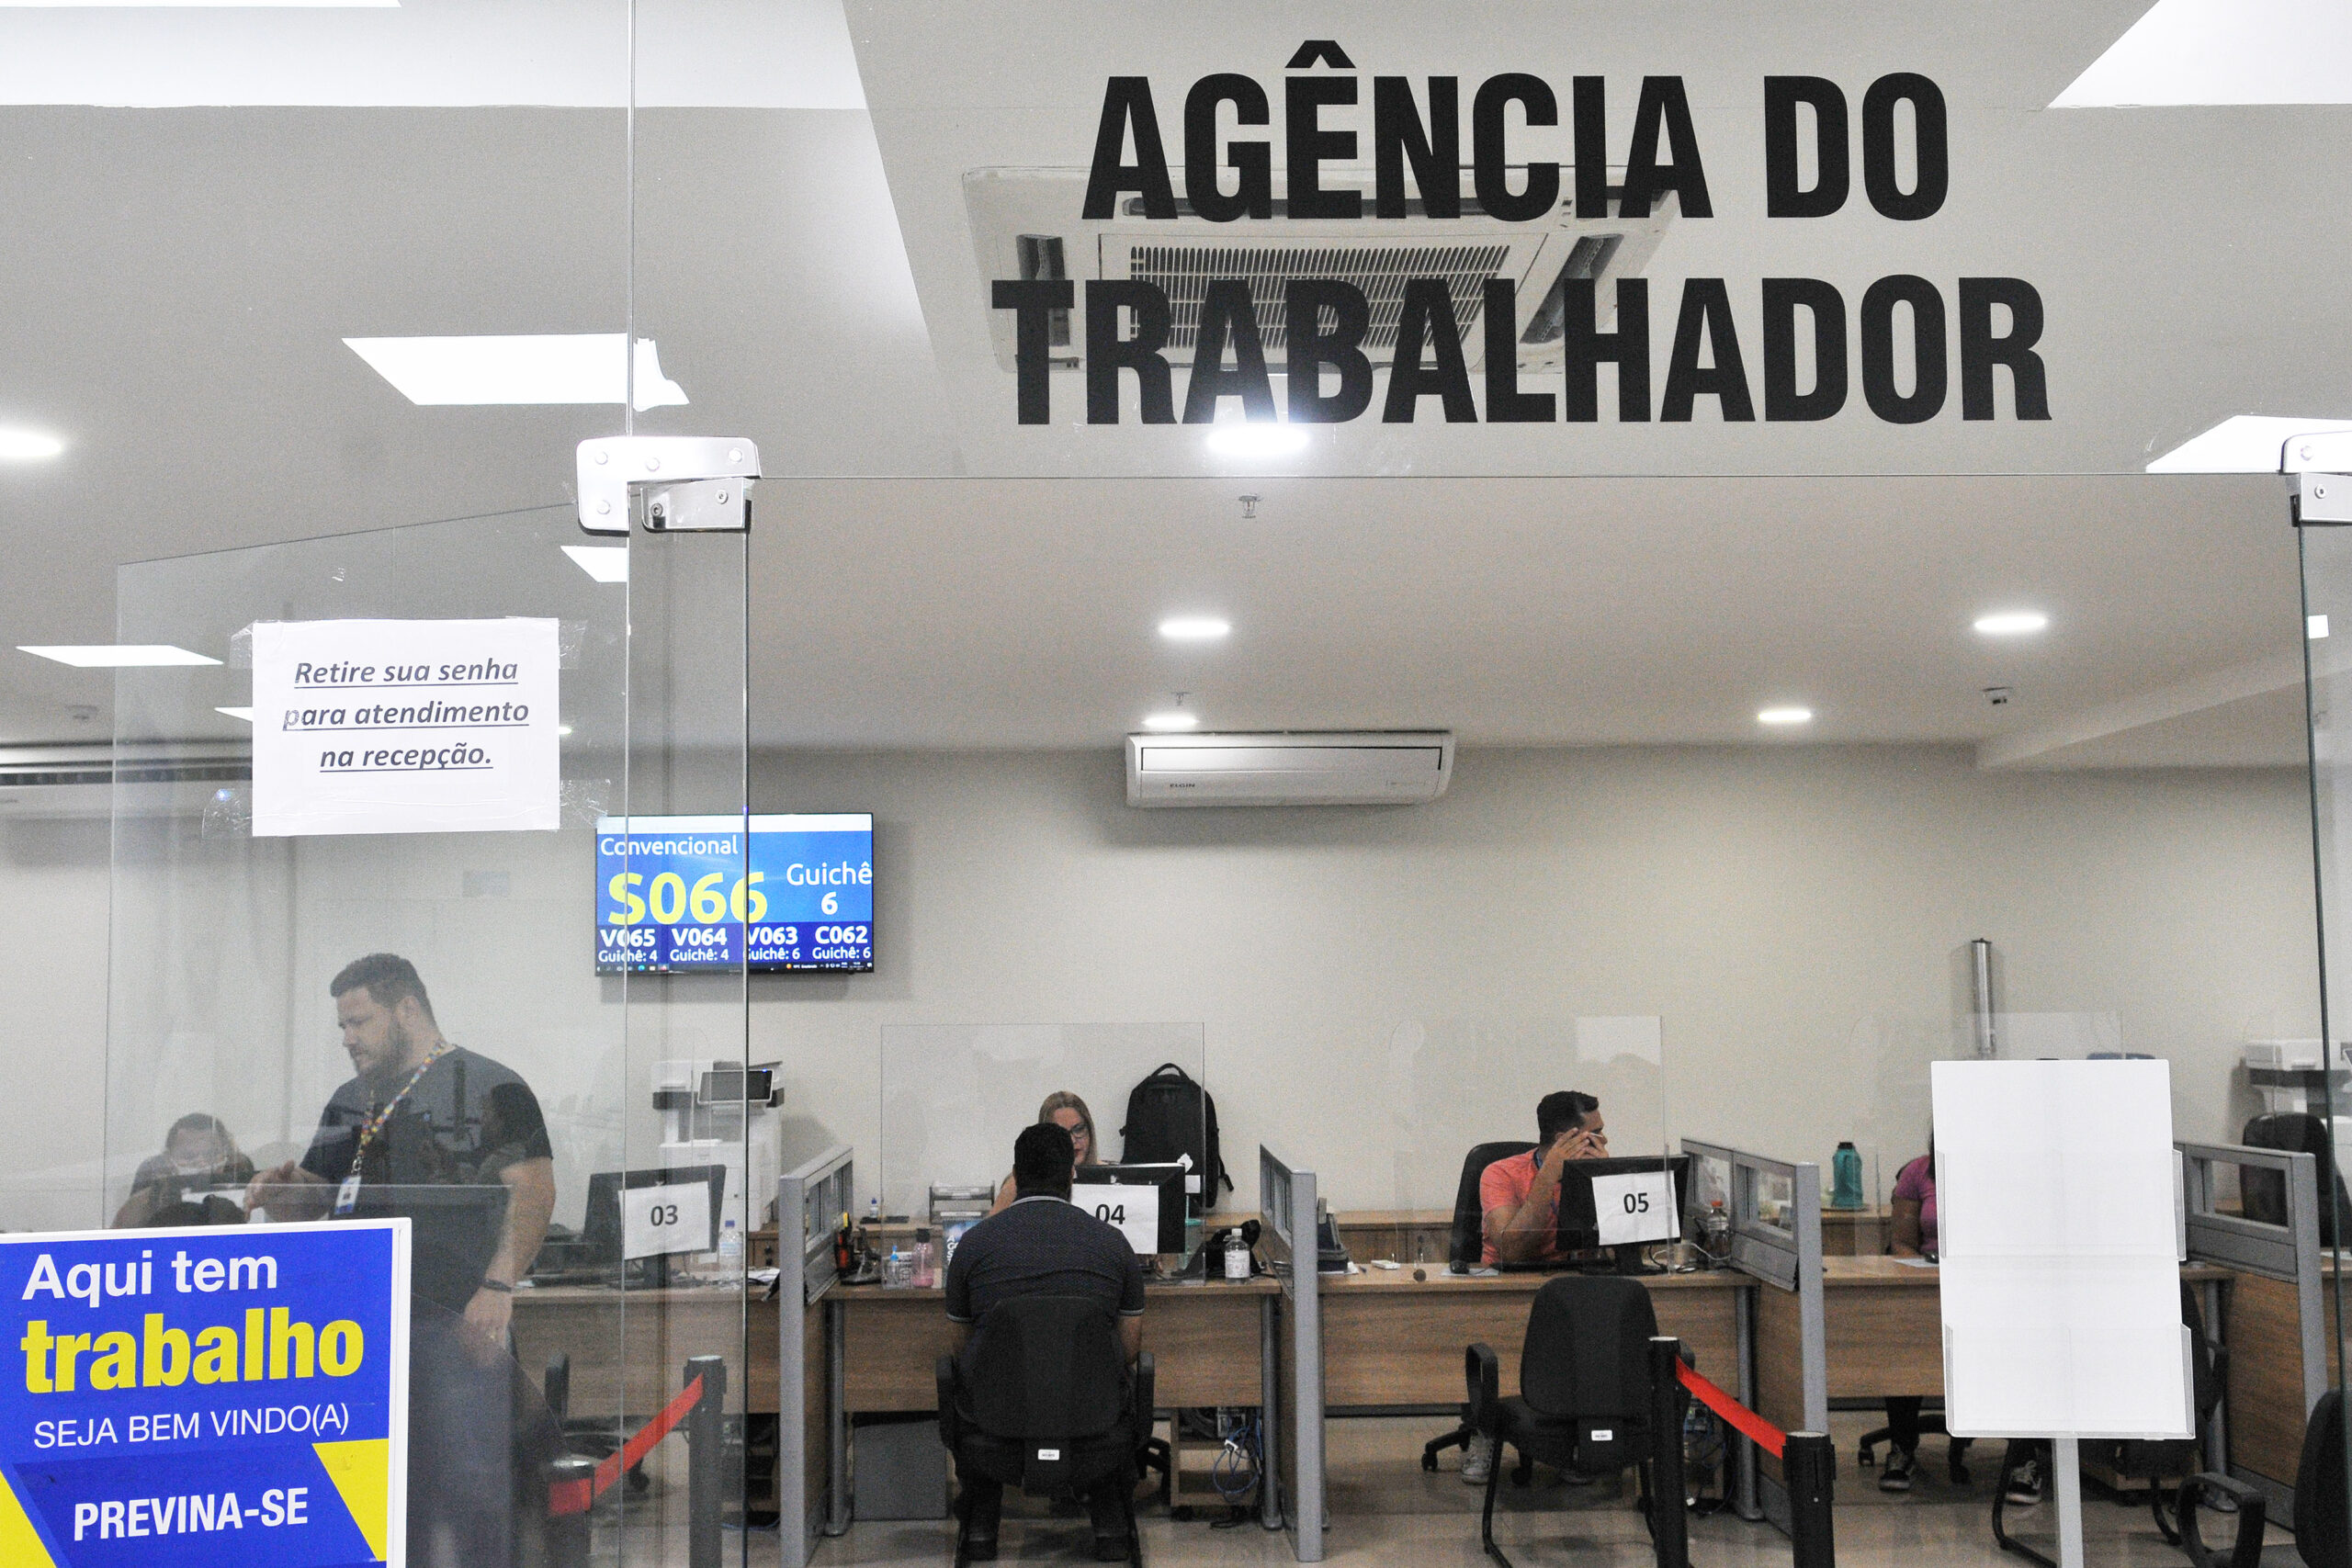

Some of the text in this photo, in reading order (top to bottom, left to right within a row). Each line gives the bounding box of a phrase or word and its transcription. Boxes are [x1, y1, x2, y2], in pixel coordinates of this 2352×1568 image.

[1082, 39, 1948, 222] AGÊNCIA DO
[991, 275, 2052, 425] TRABALHADOR
[295, 658, 518, 683] Retire sua senha
[283, 701, 529, 731] para atendimento
[320, 742, 492, 770] na recepção.
[600, 835, 739, 856] Convencional
[786, 861, 872, 886] Guichê
[607, 871, 768, 925] S066
[820, 891, 839, 916] 6
[600, 925, 868, 947] V065 V064 V063 C062
[598, 949, 658, 963] Guichê: 4
[670, 947, 729, 962] Guichê: 4
[792, 947, 800, 960] 6
[812, 946, 871, 960] Guichê: 6
[650, 1205, 678, 1226] 03
[1096, 1203, 1125, 1225] 04
[1623, 1192, 1649, 1214] 05
[22, 1250, 277, 1308] Aqui tem
[20, 1306, 364, 1393] trabalho
[34, 1403, 349, 1449] SEJA BEM VINDO(A)
[74, 1487, 309, 1541] PREVINA-SE
